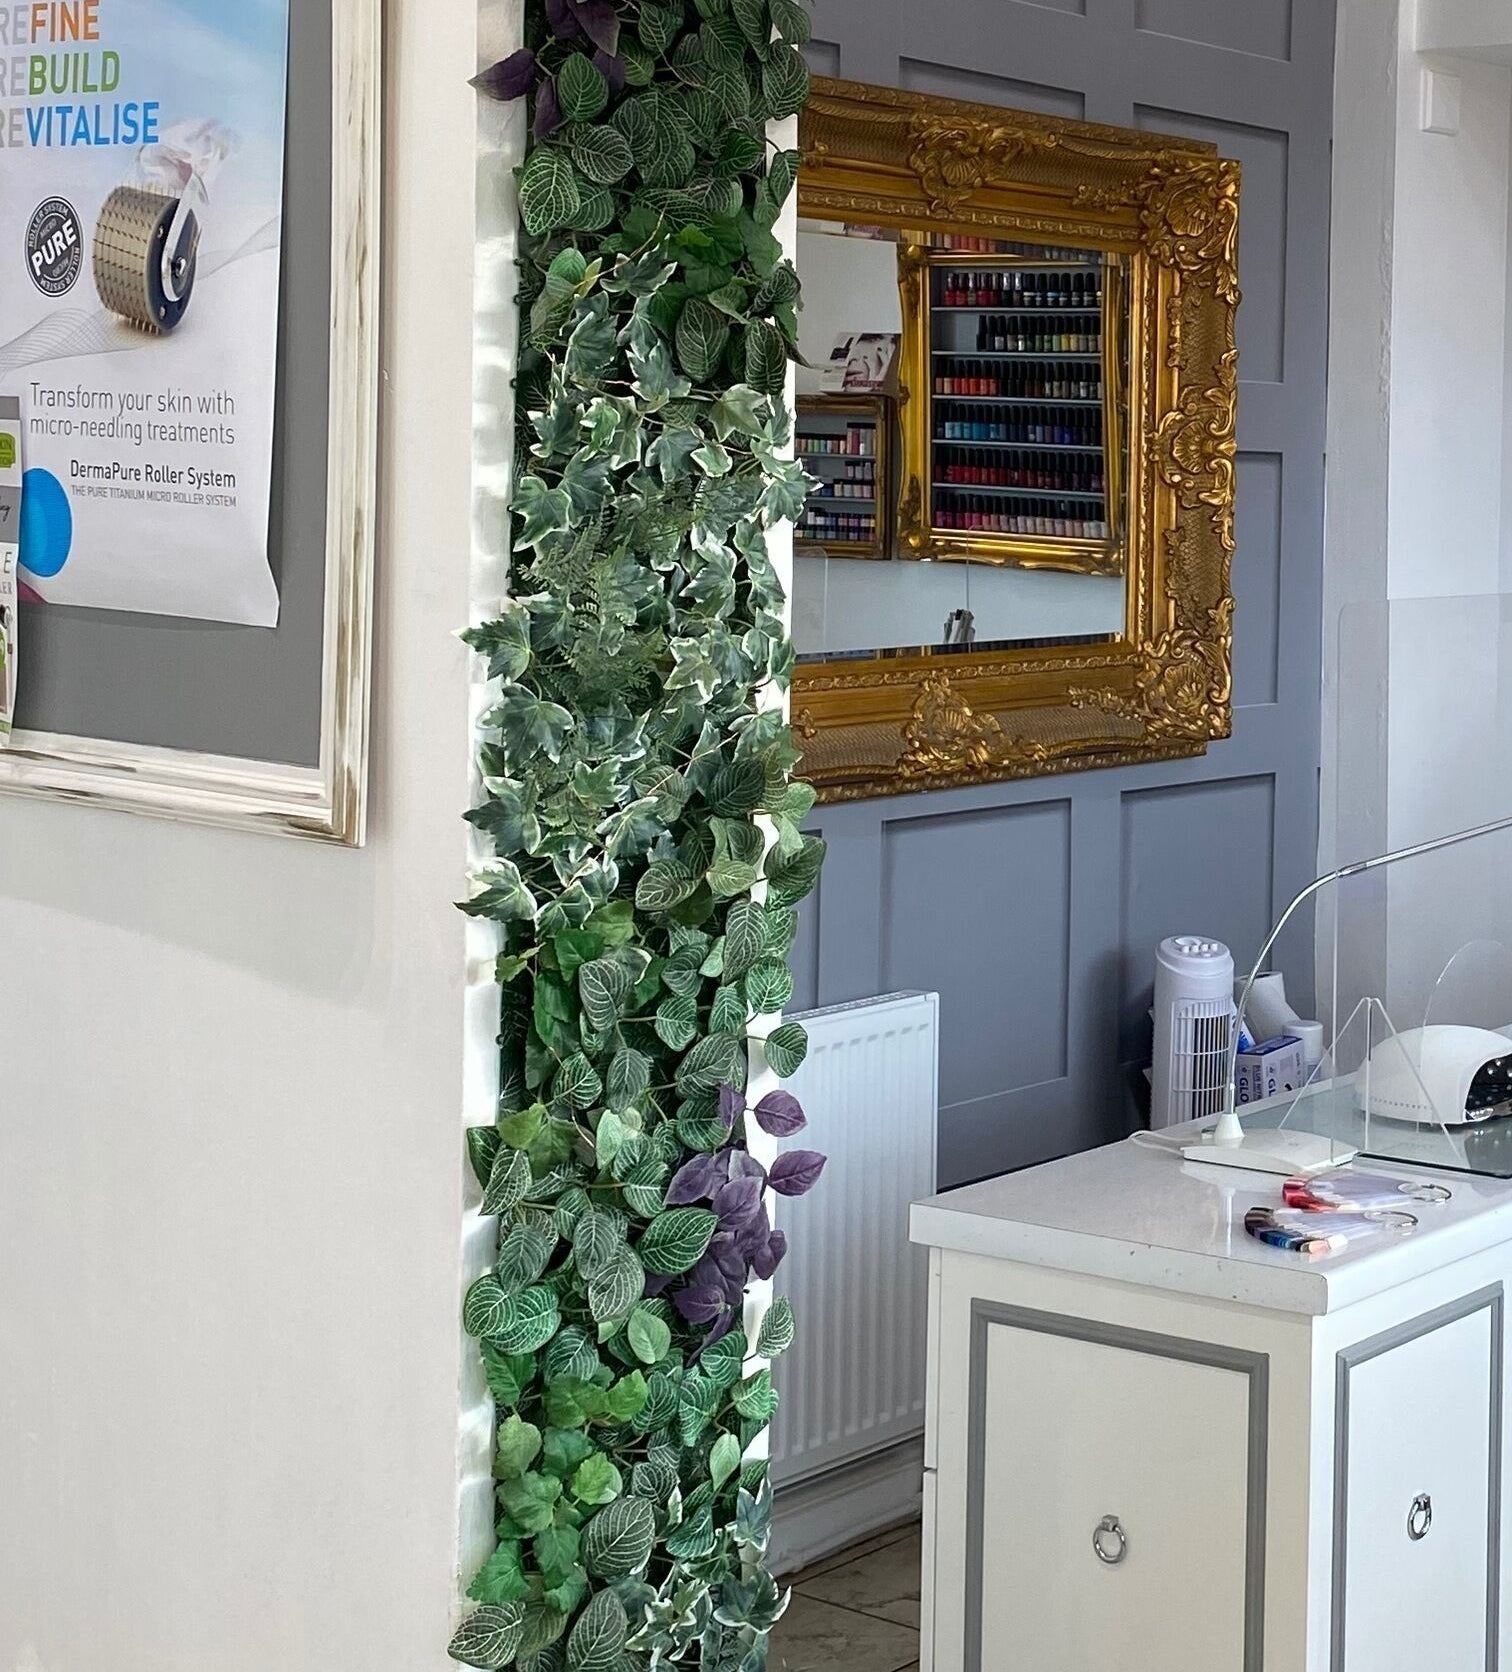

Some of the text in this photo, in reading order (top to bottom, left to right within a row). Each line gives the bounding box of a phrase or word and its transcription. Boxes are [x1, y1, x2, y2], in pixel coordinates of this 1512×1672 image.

[31, 218, 77, 277] PURE
[30, 382, 235, 417] Transform your skin with
[30, 413, 235, 446] micro-needling treatments
[70, 459, 236, 490] DermaPure Roller System
[71, 484, 237, 507] THE PURE TITANIUM MICRO ROLLER SYSTEM
